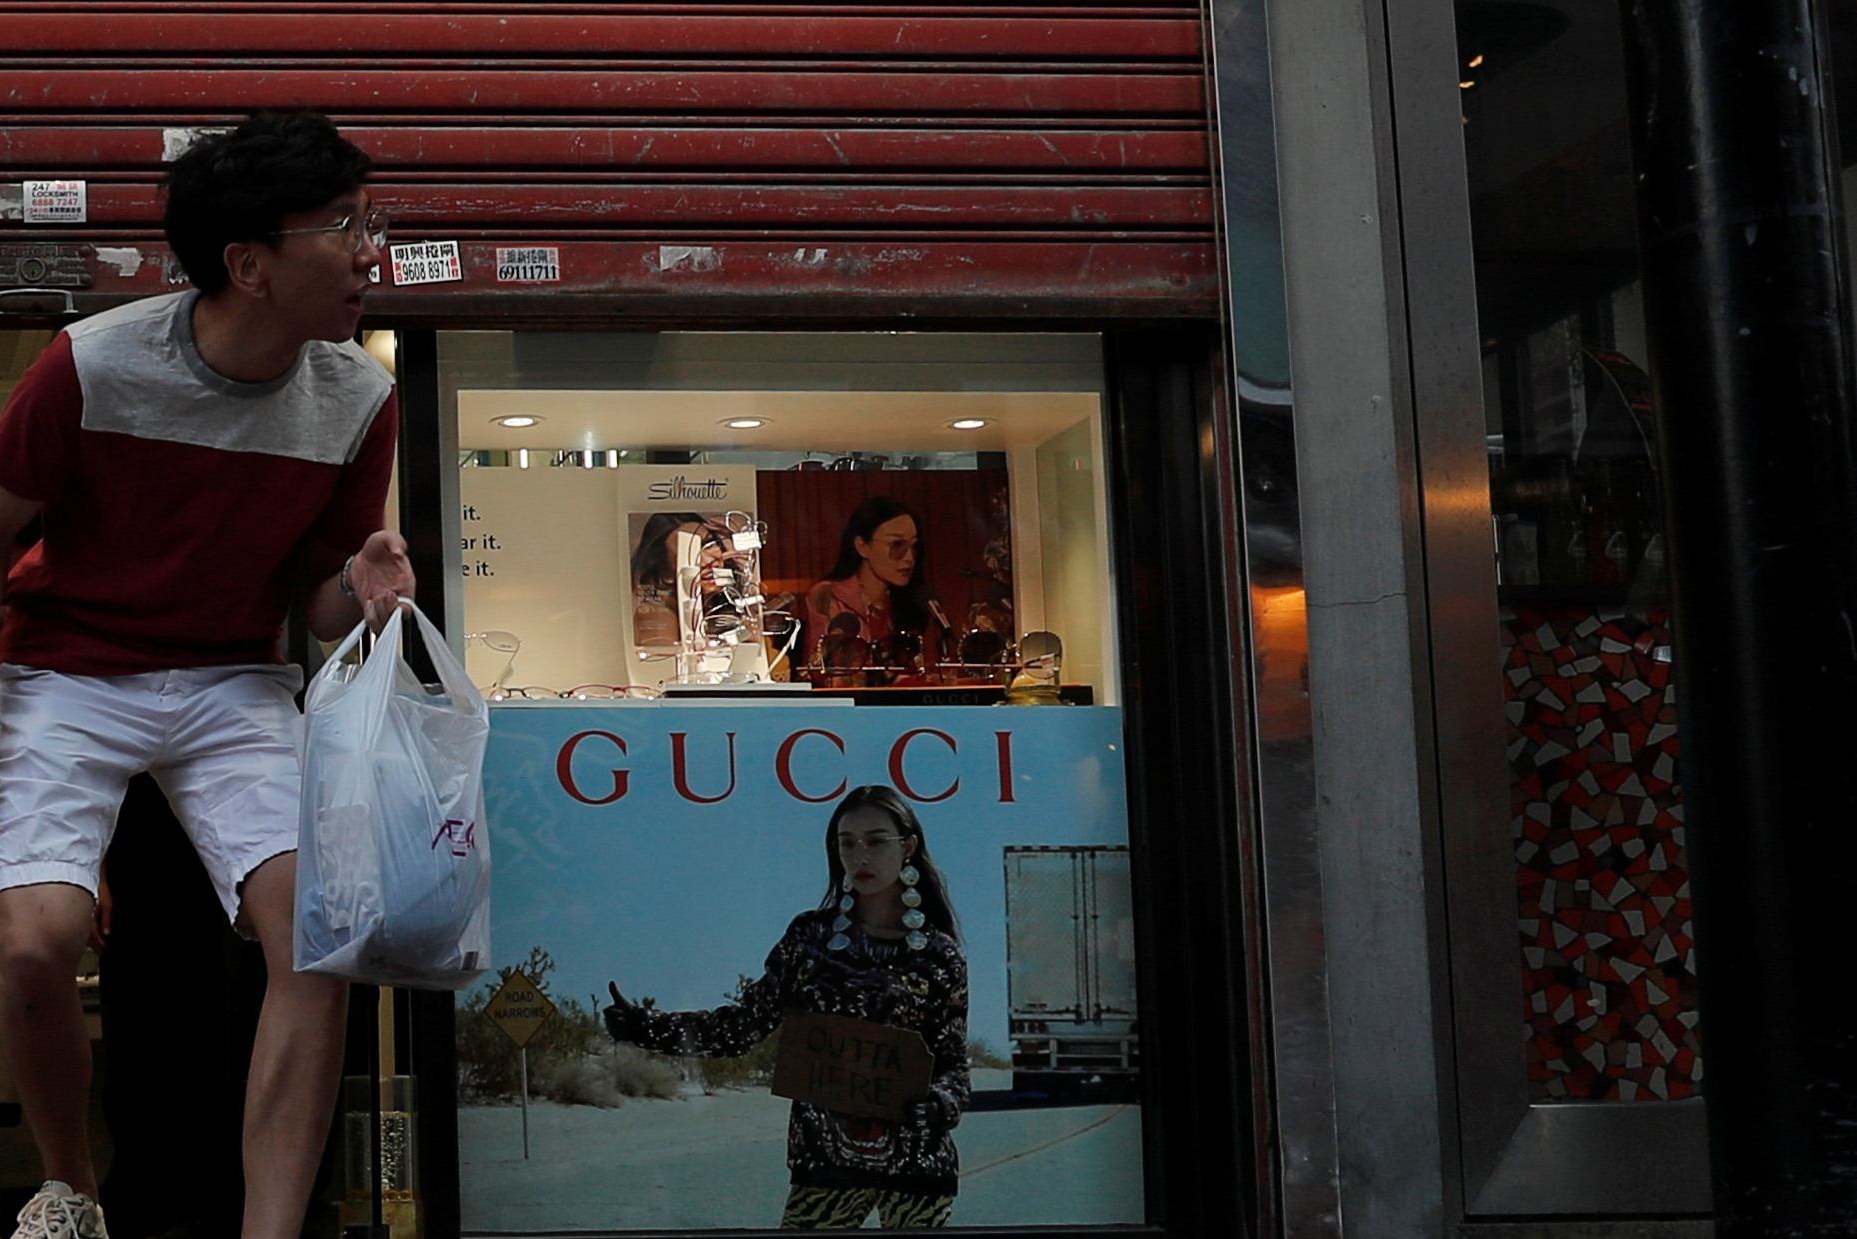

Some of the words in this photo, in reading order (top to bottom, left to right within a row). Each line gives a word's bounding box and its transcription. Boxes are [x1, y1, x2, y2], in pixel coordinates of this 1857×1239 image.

[32, 183, 50, 191] 247
[403, 262, 426, 281] 9608
[428, 259, 451, 279] 8971
[499, 264, 557, 280] 69111711
[647, 476, 728, 500] Silhouette
[463, 505, 481, 521] it.
[461, 538, 477, 550] ar
[483, 534, 501, 550] it.
[476, 560, 494, 576] it.
[556, 728, 1016, 805] GUCCI
[505, 991, 535, 1003] ROAD
[494, 1007, 547, 1020] NARROWS
[807, 1026, 903, 1075] OUTTA
[808, 1061, 892, 1107] HERE
